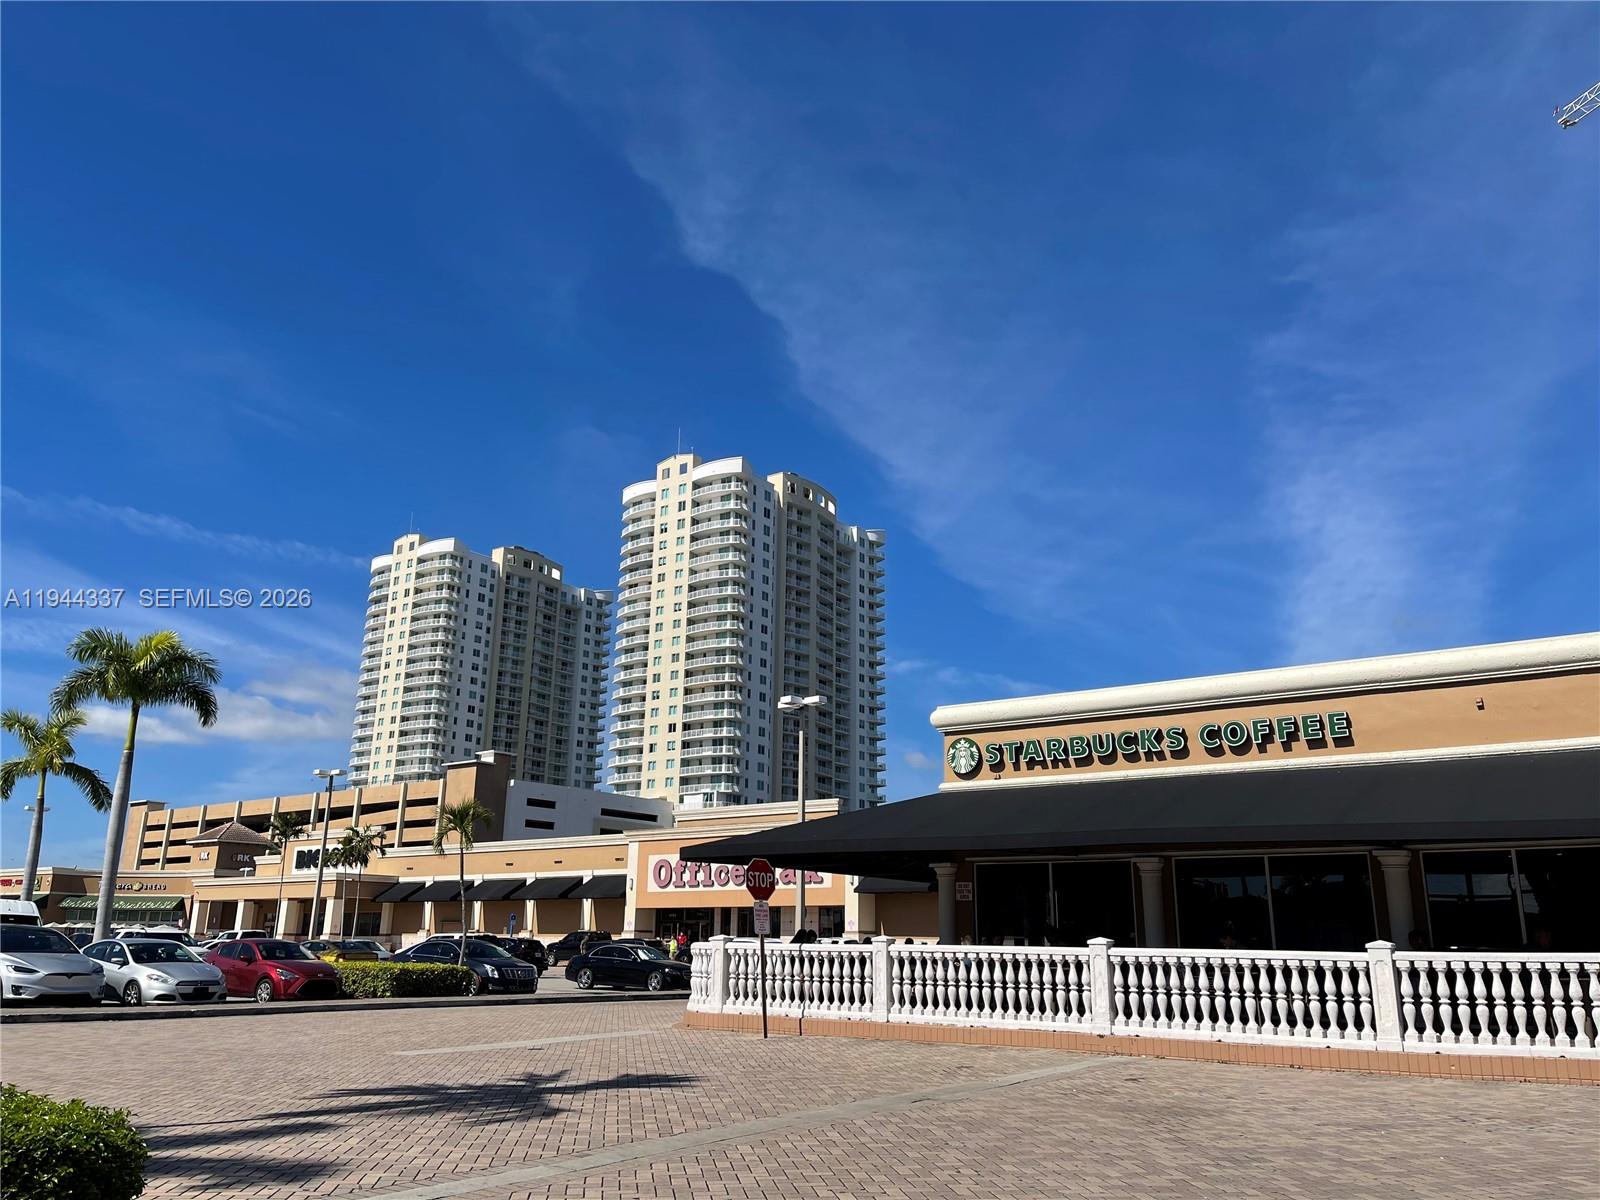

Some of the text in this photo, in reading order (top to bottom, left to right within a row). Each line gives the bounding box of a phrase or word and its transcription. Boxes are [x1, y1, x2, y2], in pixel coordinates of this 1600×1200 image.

[984, 711, 1351, 765] STARBUCKS COFFEE
[652, 858, 824, 889] Officea
[747, 871, 775, 888] STOP
